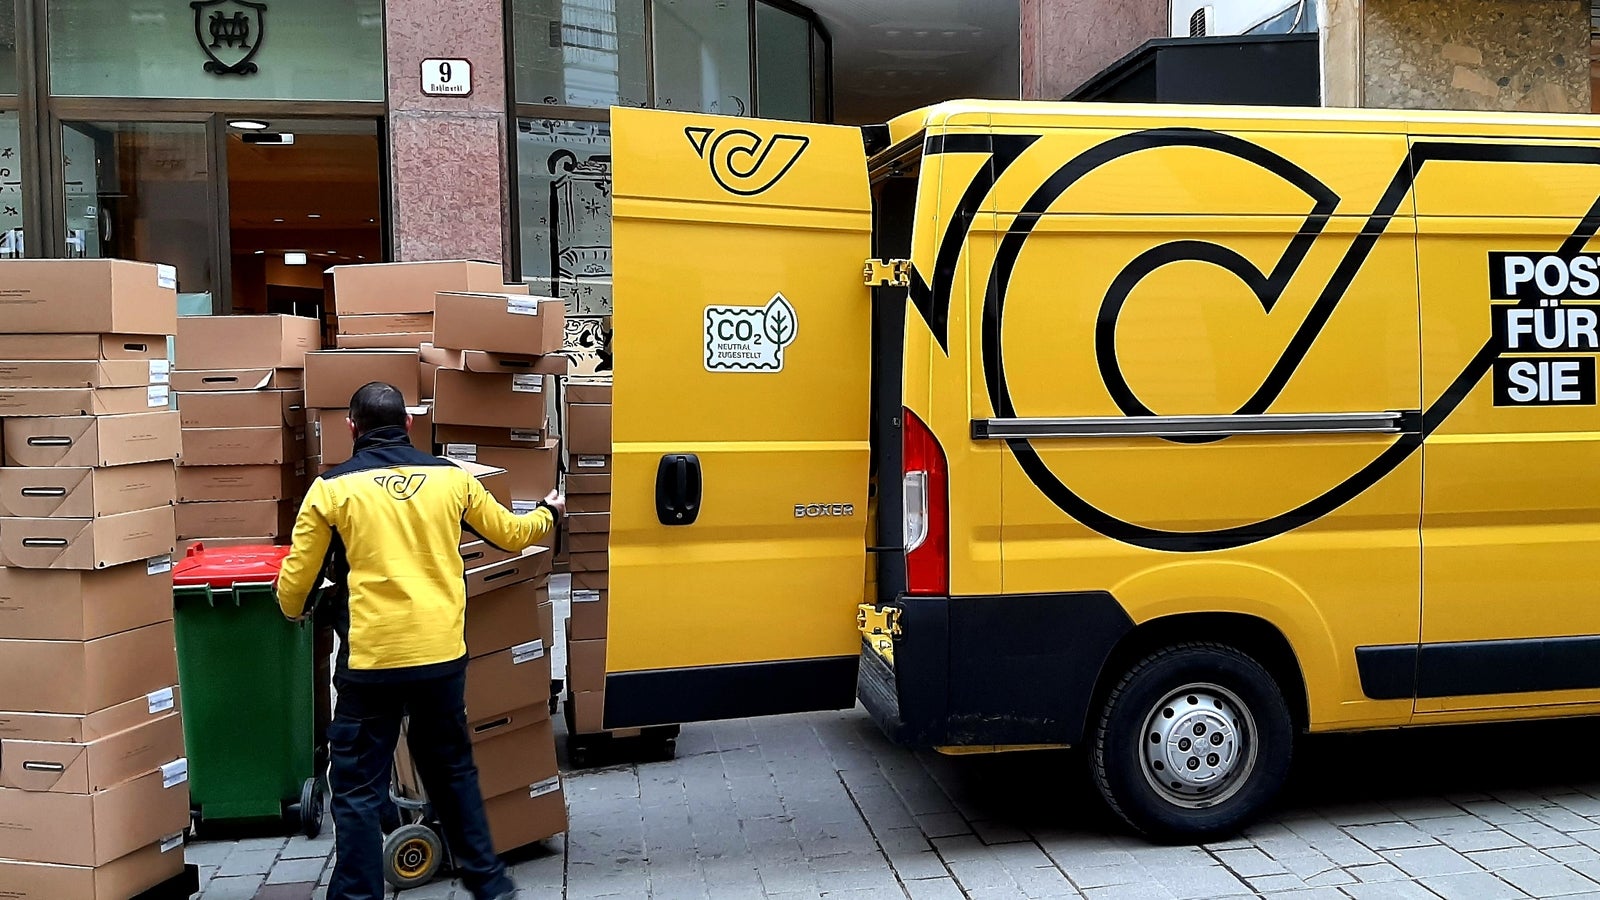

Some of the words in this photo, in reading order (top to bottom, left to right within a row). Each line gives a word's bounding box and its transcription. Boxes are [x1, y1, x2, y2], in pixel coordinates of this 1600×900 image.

[439, 62, 452, 83] 9
[1504, 255, 1600, 296] POS
[1507, 299, 1599, 349] FÜR
[717, 343, 751, 351] NEUTRAL
[717, 351, 762, 359] ZUGESTELLT
[1507, 361, 1581, 402] SIE
[794, 502, 854, 518] BOXER
